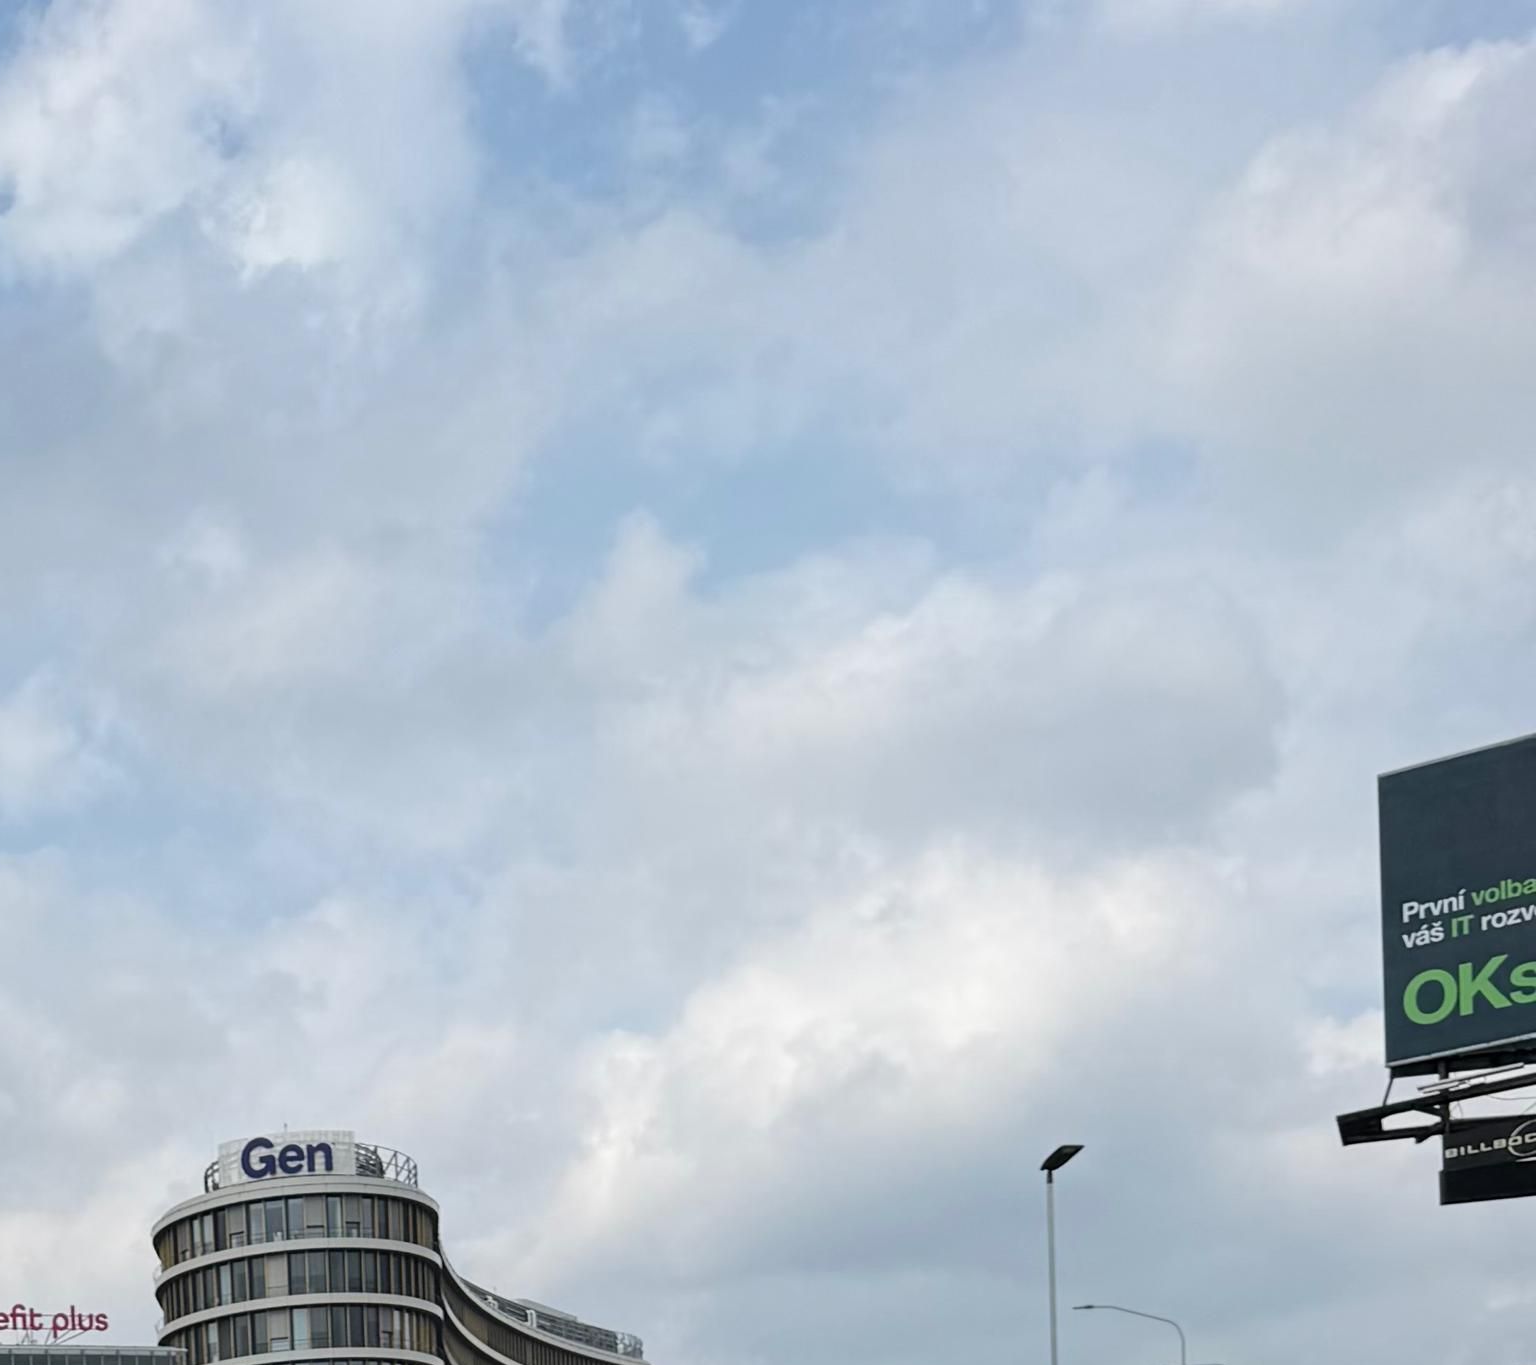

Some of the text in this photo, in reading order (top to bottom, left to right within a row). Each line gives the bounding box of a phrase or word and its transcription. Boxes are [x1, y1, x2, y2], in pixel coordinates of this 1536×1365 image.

[1402, 878, 1536, 923] První volba
[1402, 904, 1536, 948] váš IT rozv
[241, 1137, 333, 1178] Gen
[52, 1305, 109, 1339] plus
